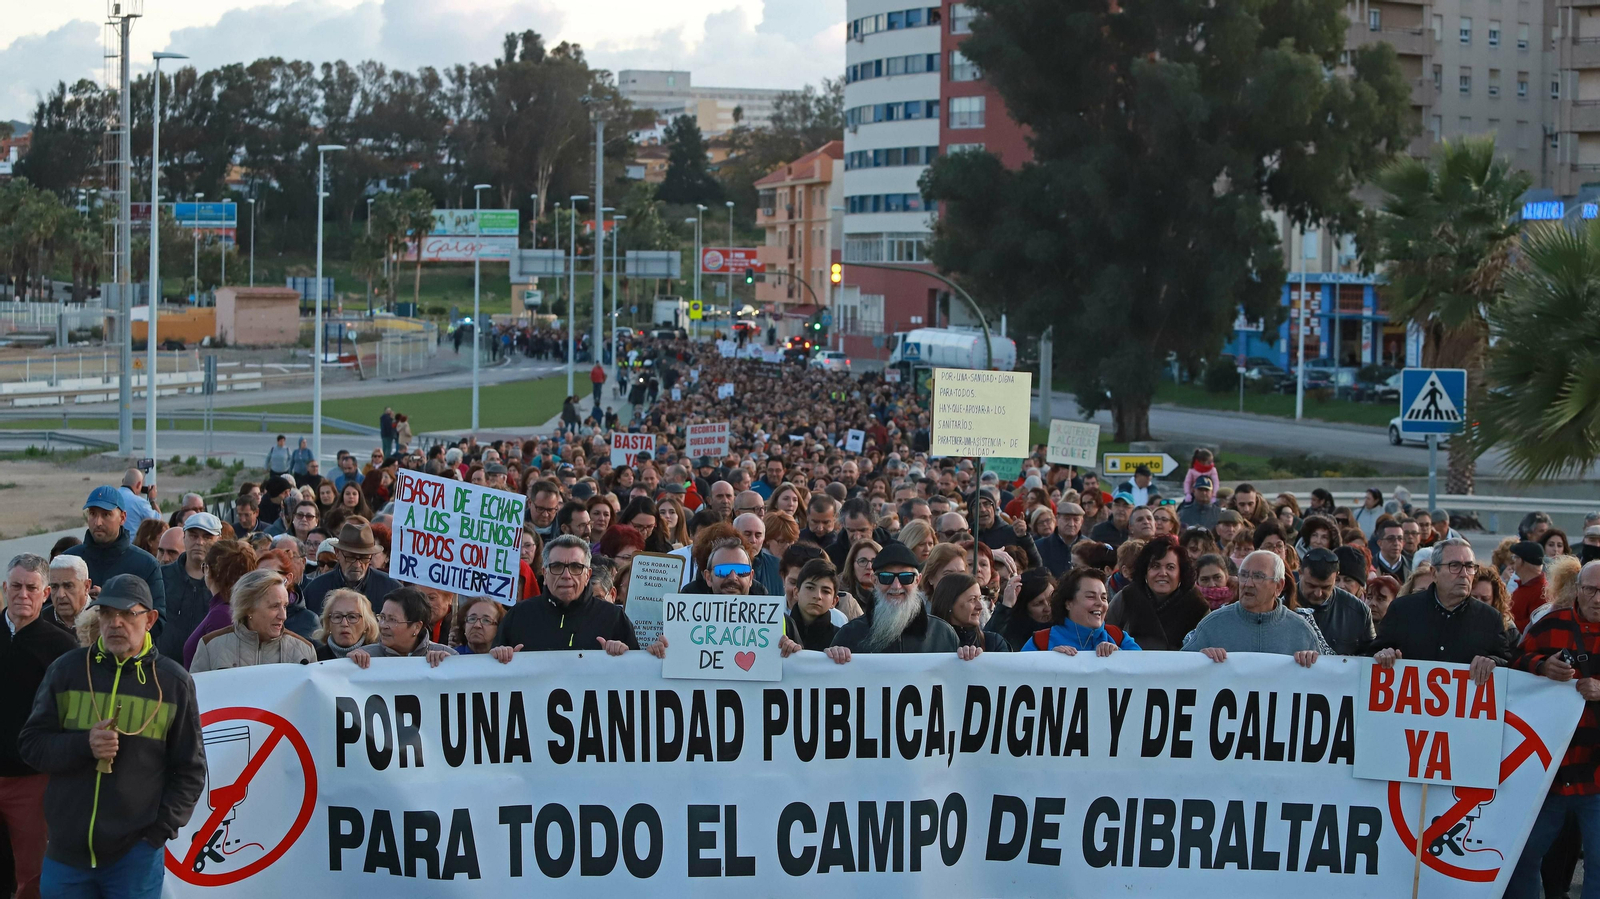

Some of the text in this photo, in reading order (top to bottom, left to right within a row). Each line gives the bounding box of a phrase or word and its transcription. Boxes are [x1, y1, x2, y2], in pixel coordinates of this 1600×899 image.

[614, 434, 653, 450] BASTA
[690, 424, 726, 434] RECORTA EN
[690, 436, 726, 446] SUELDOS NO
[1010, 438, 1018, 448] DE
[693, 447, 722, 456] EN SALUD
[454, 486, 472, 516] DE
[480, 493, 524, 525] ECHAR
[404, 505, 522, 552] A LOS BUENOS!!
[460, 543, 488, 569] CON
[494, 548, 512, 575] EL
[399, 554, 515, 602] DR. GUTIÉRREZ!
[666, 598, 780, 624] DR. GUTIÉRREZ
[690, 625, 770, 648] GRACIAS
[700, 650, 724, 670] DE
[1368, 663, 1498, 721] BASTA
[335, 694, 424, 771] POR
[440, 691, 532, 768] UNA
[547, 688, 744, 765] SANIDAD
[1108, 688, 1133, 758] Y
[1141, 688, 1197, 759] DE
[1209, 688, 1355, 765] CALIDA
[1404, 729, 1452, 780] YA
[328, 792, 1382, 880] PARA TODO EL CAMPO DE GIBRALTAR
